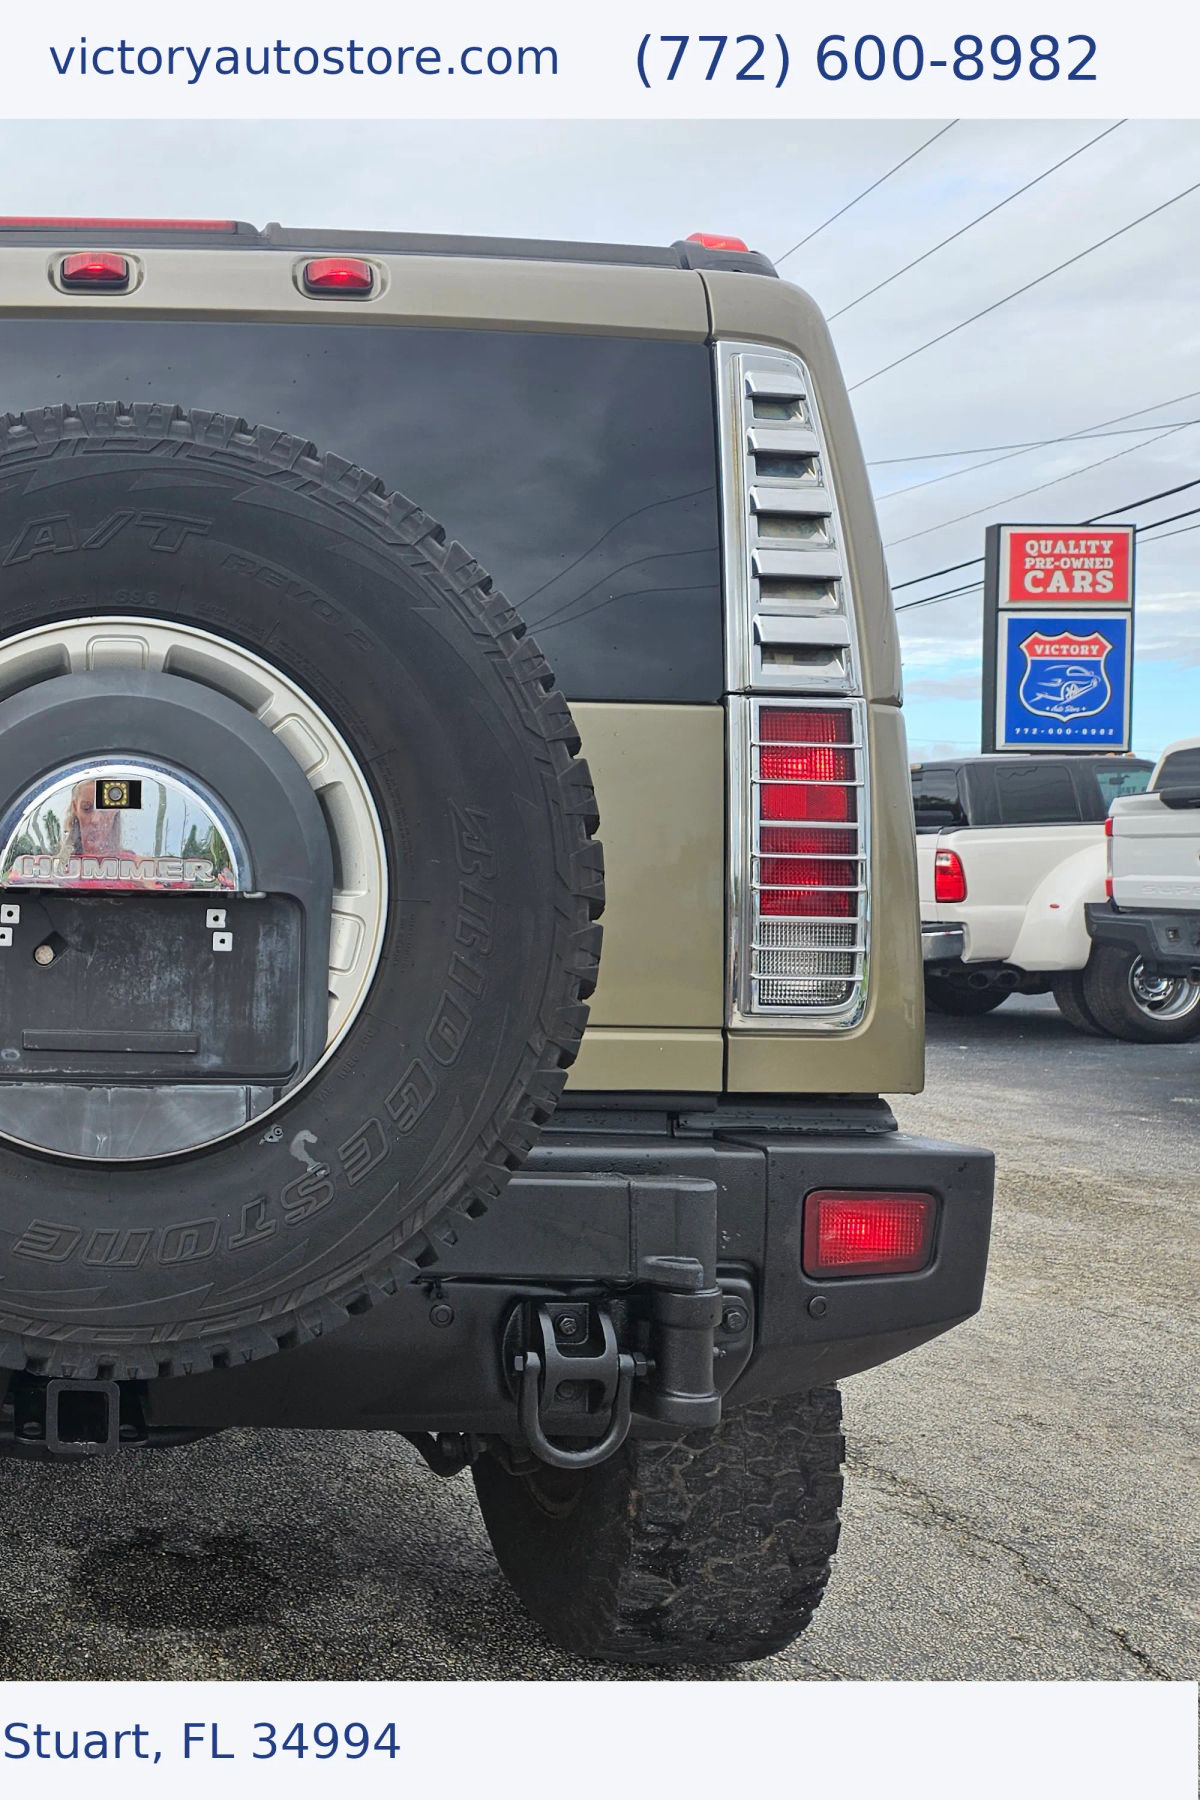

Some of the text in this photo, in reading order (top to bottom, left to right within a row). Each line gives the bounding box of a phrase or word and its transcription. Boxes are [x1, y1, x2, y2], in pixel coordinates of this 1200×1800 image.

[1025, 540, 1114, 556] QUALITY
[2, 506, 214, 567] A/T
[220, 552, 343, 624] REVO
[1024, 557, 1114, 569] PRE-OWNED
[1023, 570, 1114, 593] CARS
[1034, 644, 1099, 655] VICTORY
[20, 856, 217, 882] HUMMER
[10, 795, 498, 1270] BRIDGESTONE
